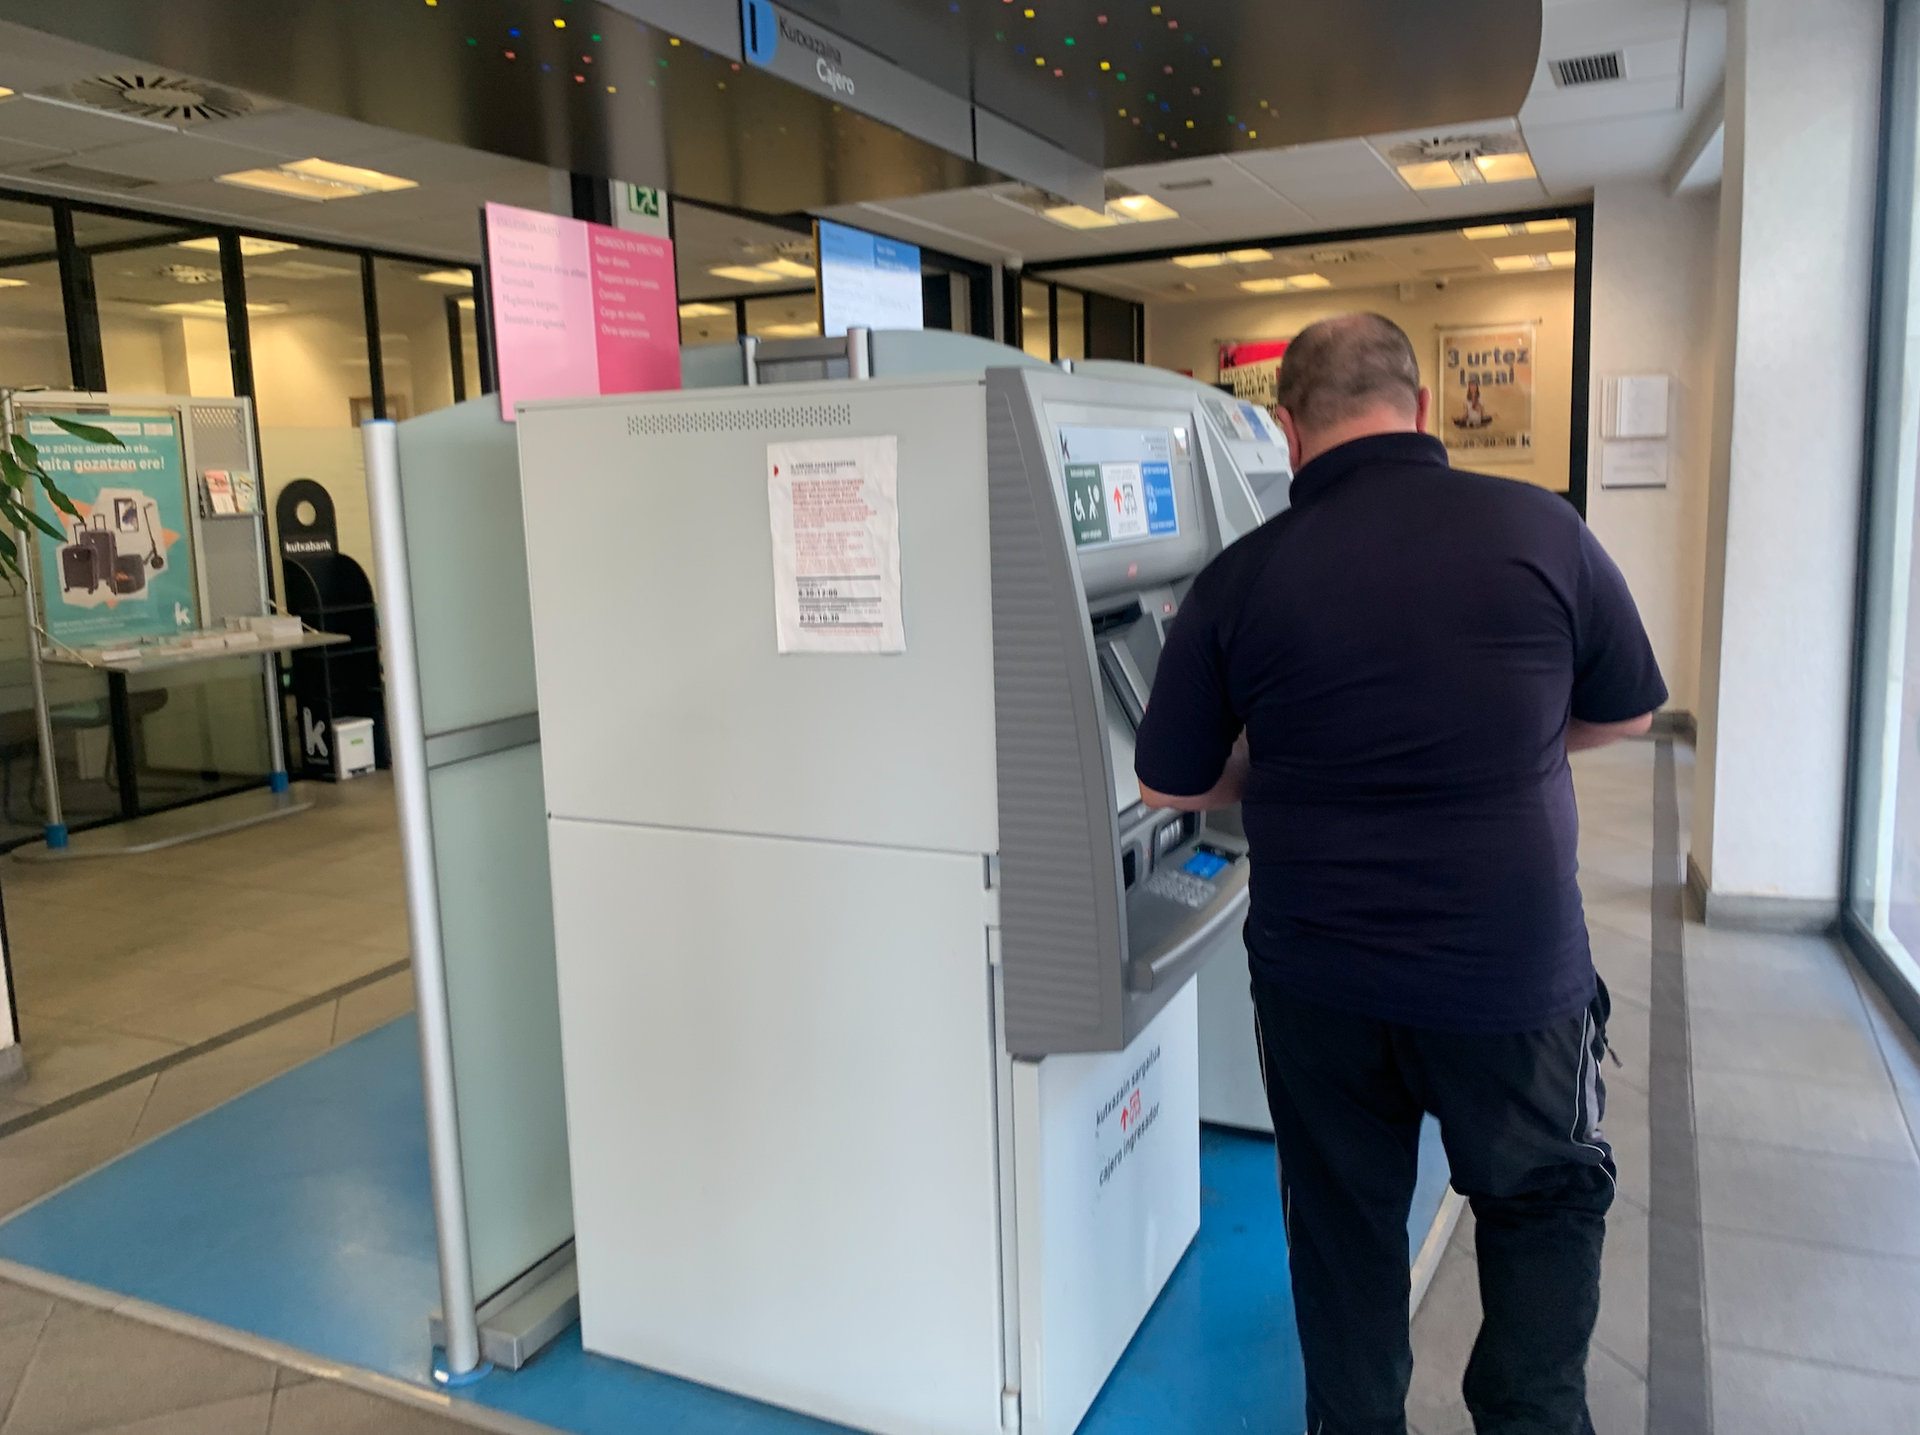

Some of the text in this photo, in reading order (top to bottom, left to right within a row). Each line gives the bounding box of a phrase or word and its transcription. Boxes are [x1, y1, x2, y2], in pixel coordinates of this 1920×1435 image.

[816, 57, 855, 95] Cajero
[1447, 346, 1529, 369] 3 urtez
[74, 458, 136, 473] gozatzen
[139, 455, 165, 471] ere!
[286, 539, 332, 553] kutxabank
[175, 601, 190, 626] k
[303, 707, 328, 757] k
[1096, 1043, 1161, 1127] kutxazain sargailua
[1099, 1101, 1160, 1187] cajero ingresador
